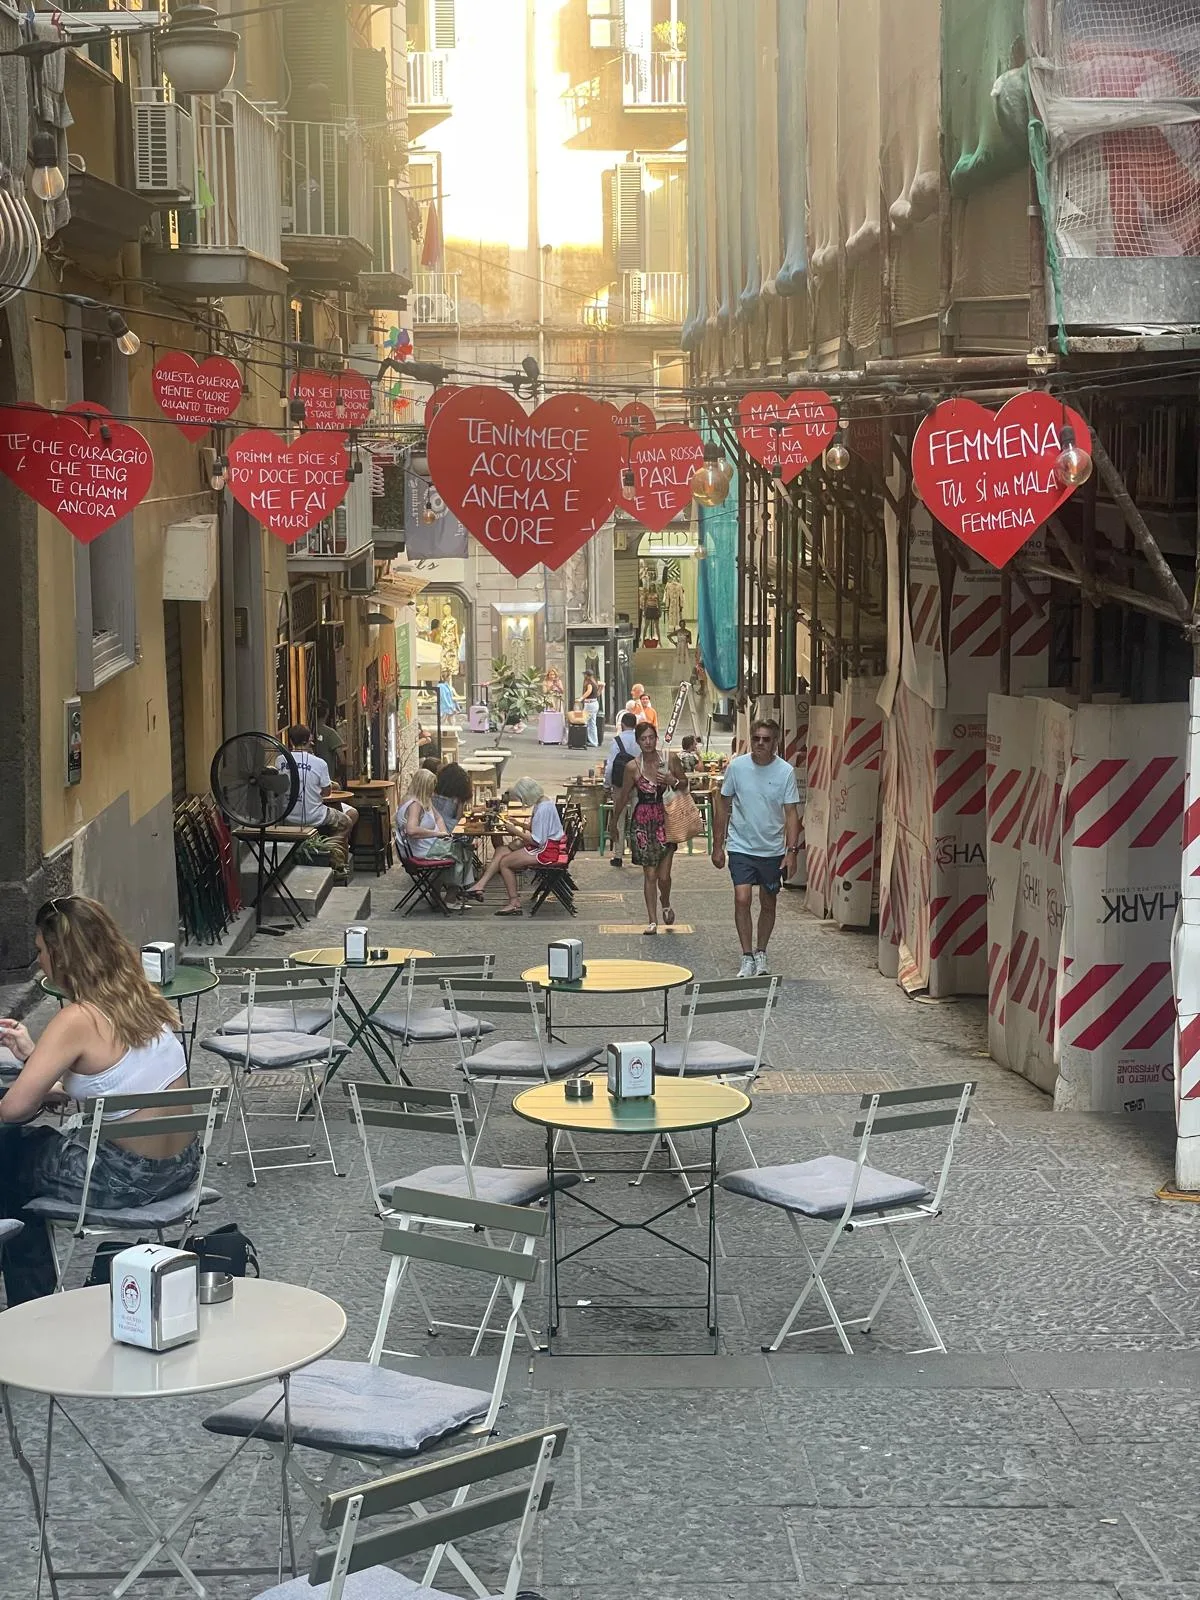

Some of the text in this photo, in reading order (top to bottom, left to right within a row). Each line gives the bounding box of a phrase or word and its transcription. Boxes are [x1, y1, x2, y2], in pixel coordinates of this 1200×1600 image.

[156, 370, 240, 389] QUESTA GUERRA
[160, 385, 230, 402] MENTE CUORE
[318, 384, 333, 398] SEI
[336, 386, 371, 400] TRISTE
[161, 399, 230, 416] QUANTO TEMPO
[316, 400, 336, 408] SOLO
[750, 402, 825, 421] MALATIA
[458, 417, 590, 452] TENIMMECE
[929, 421, 1062, 466] FEMMENA
[32, 439, 148, 466] CHE CURAGGIO
[670, 446, 704, 462] ROSSA
[782, 440, 802, 452] NA
[236, 449, 272, 464] PRIMM
[278, 454, 294, 464] ME
[298, 450, 325, 464] DICE
[50, 460, 128, 482] CHE TENG
[231, 468, 344, 485] PO' DOCE DOCE
[46, 478, 128, 500] TE CHIAMM
[936, 468, 1058, 508] TU SI NA MALA
[250, 487, 326, 514] ME FAI
[461, 484, 550, 512] ANEMA
[564, 489, 580, 512] E
[650, 490, 677, 509] TE
[57, 499, 117, 518] ANCORA
[485, 515, 555, 545] CORE
[961, 507, 1036, 534] FEMMENA
[1102, 891, 1181, 924] HARK
[1117, 1064, 1160, 1074] AFFISSIONE
[1116, 1074, 1160, 1084] DIVIETO DI
